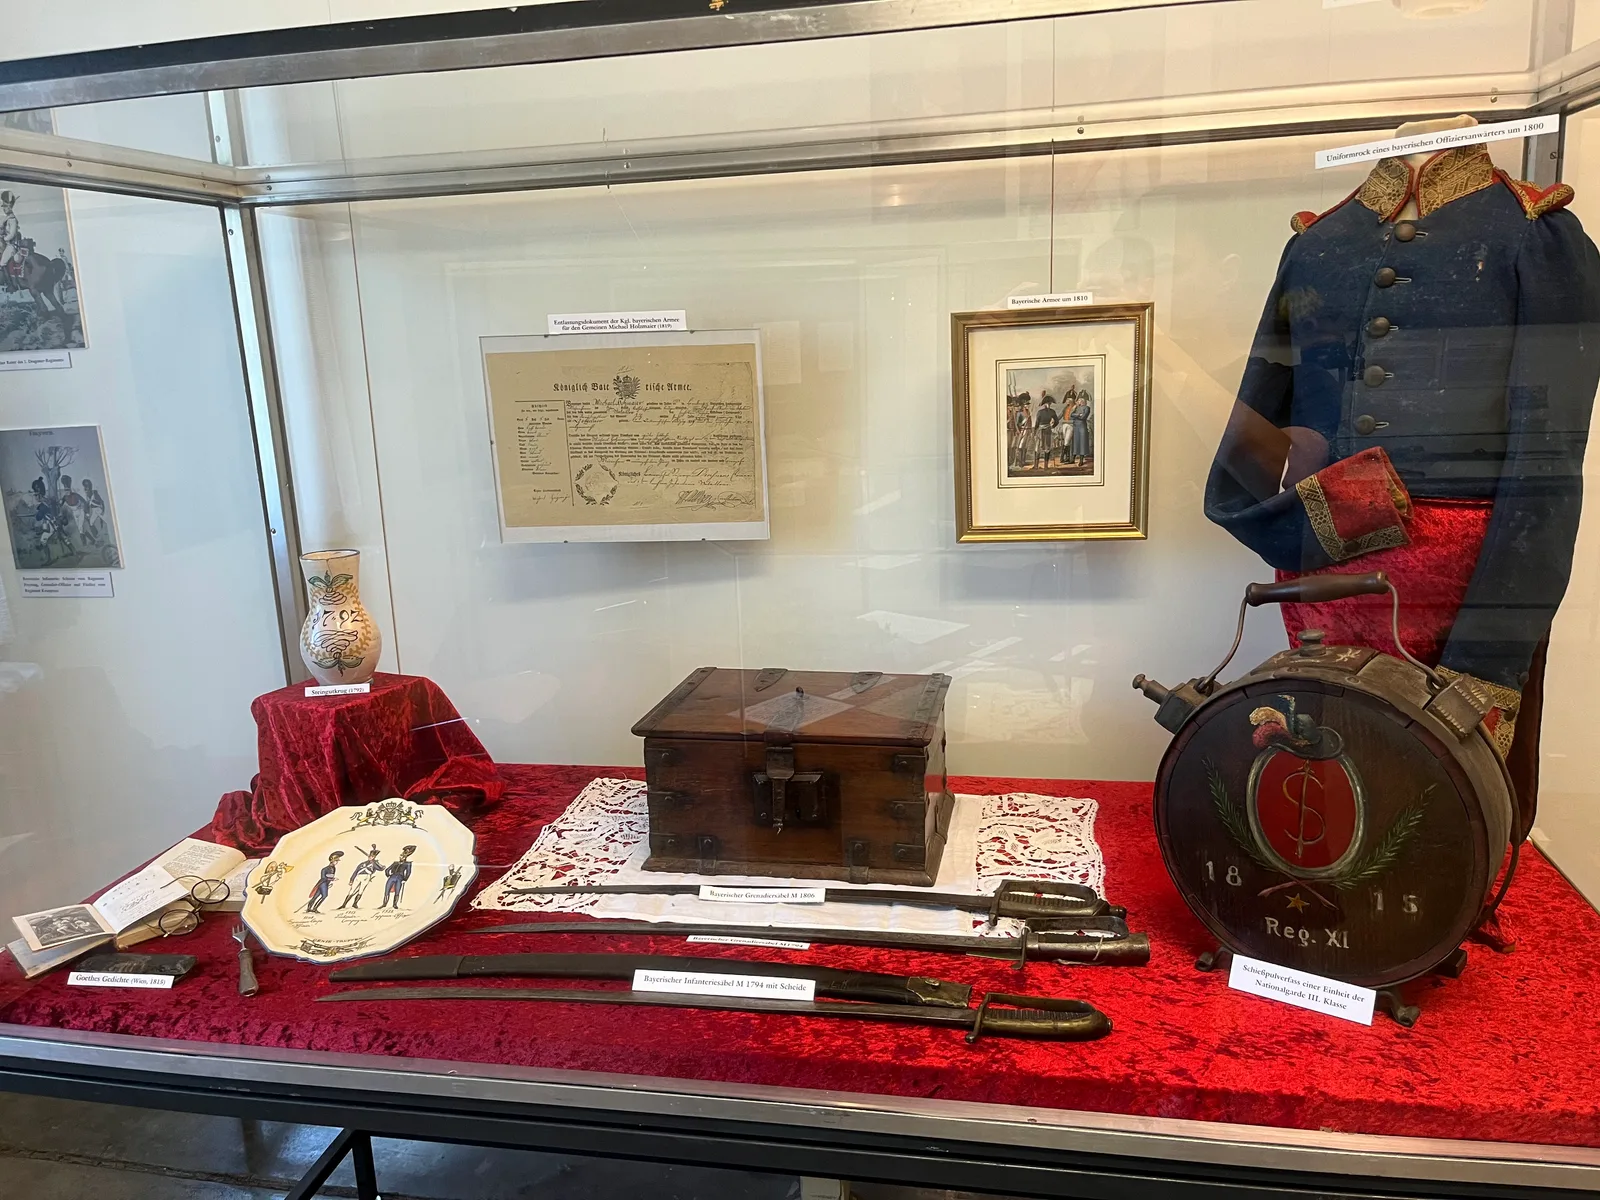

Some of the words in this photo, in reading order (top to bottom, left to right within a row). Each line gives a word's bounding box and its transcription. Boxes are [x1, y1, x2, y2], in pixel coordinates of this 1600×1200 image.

[1326, 149, 1371, 162] Uniformrock
[1372, 146, 1390, 154] eines
[1391, 140, 1434, 152] bayerischen
[1435, 129, 1506, 144] Offiziersanwärters
[1523, 122, 1545, 132] 1800
[1011, 298, 1041, 306] Bayerische
[709, 890, 743, 899] Bayerischer
[745, 891, 790, 899] Grenadiersäbel
[1264, 916, 1317, 947] Reg.
[75, 974, 100, 983] Goethes
[102, 975, 130, 983] Gedichte
[130, 977, 148, 985] (Wien,
[150, 978, 166, 986] 1815)
[643, 975, 682, 984] Bayerischer
[684, 977, 735, 987] Infanteriesäbel
[746, 980, 764, 988] 1794
[780, 983, 807, 992] Scheide
[1242, 964, 1301, 985] Schießpulverfass
[1302, 980, 1321, 991] einer
[1323, 985, 1350, 999] Einheit
[1352, 994, 1365, 1003] der
[1255, 979, 1306, 999] Nationalgarde
[1308, 993, 1321, 1003] III.
[1323, 997, 1348, 1010] Klasse
